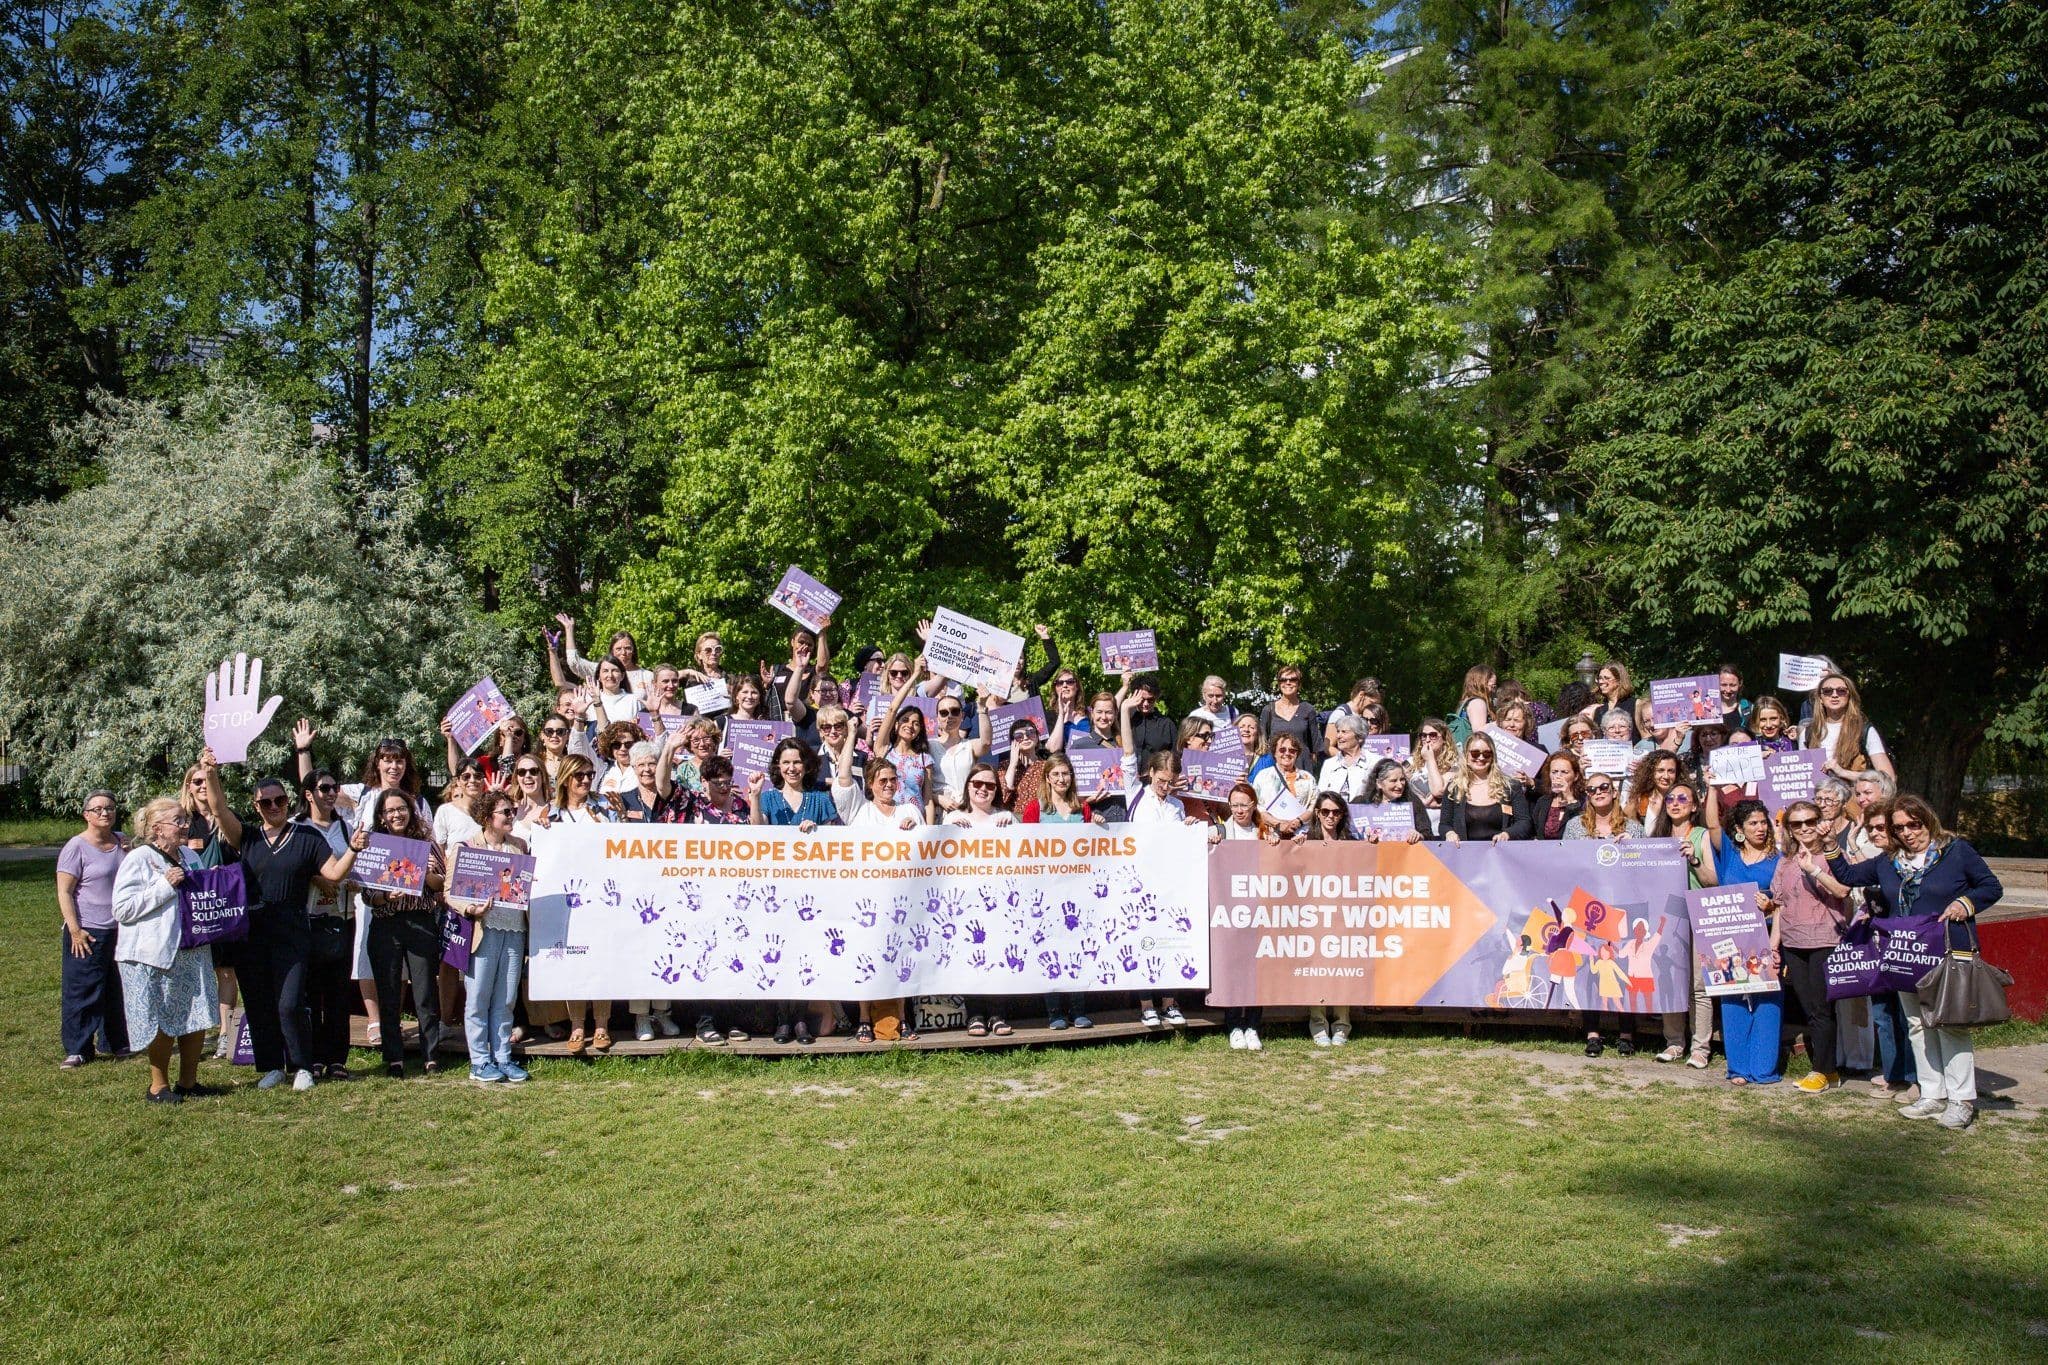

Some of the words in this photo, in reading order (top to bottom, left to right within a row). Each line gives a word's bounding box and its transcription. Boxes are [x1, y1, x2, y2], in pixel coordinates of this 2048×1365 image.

[937, 623, 967, 640] 78.000
[932, 642, 957, 654] STRONG
[928, 652, 954, 665] AGAINST
[956, 663, 980, 674] WOMEN
[930, 646, 966, 663] COMBATING
[968, 660, 997, 675] VIOLENCE
[1653, 681, 1696, 690] PROSTITUTION
[209, 711, 253, 729] STOP
[1221, 729, 1238, 737] RAPE
[1498, 752, 1522, 770] OLENCE
[1769, 763, 1813, 774] VIOLENCE
[1773, 772, 1812, 783] AGAINST
[1772, 782, 1806, 791] WOMEN
[1781, 791, 1807, 800] GIRLS
[606, 839, 677, 859] MAKE
[685, 840, 785, 861] EUROPE
[793, 841, 853, 862] SAFE
[862, 841, 911, 862] FOR
[917, 839, 1010, 859] WOMEN
[1017, 838, 1067, 858] AND
[1073, 837, 1137, 857] GIRLS
[358, 852, 386, 862] GAINST
[460, 852, 510, 863] PROSTITUTION
[355, 861, 380, 869] OMEN
[458, 863, 492, 872] EXPLOITATION
[661, 866, 705, 877] ADOPT
[708, 867, 716, 877] A
[720, 867, 769, 878] ROBUST
[773, 868, 836, 879] DIRECTIVE
[840, 868, 858, 879] ON
[862, 867, 933, 879] COMBATING
[936, 866, 993, 876] VIOLENCE
[996, 865, 1046, 875] AGAINST
[1048, 864, 1091, 874] WOMEN
[1231, 874, 1288, 898] END
[1293, 874, 1430, 898] VIOLENCE
[197, 890, 216, 900] BAG
[1701, 895, 1731, 907] RAPE
[1732, 893, 1745, 903] IS
[192, 900, 215, 910] FULL
[215, 898, 227, 907] OF
[192, 906, 244, 921] SOLIDARITY
[1210, 905, 1337, 928] AGAINST
[1342, 905, 1450, 928] WOMEN
[1707, 905, 1742, 916] SEXUAL
[1699, 913, 1757, 925] EXPLOITATION
[1894, 930, 1916, 940] BAG
[1256, 935, 1315, 958] AND
[1320, 935, 1403, 958] GIRLS
[1835, 943, 1853, 952] BAG
[1912, 942, 1928, 953] OF
[1828, 953, 1850, 964] FULL
[1850, 950, 1865, 959] OF
[1883, 950, 1944, 966] SOLIDARITY
[1828, 959, 1880, 973] SOLIDARITY
[1294, 968, 1364, 977] #ENDVAWG
